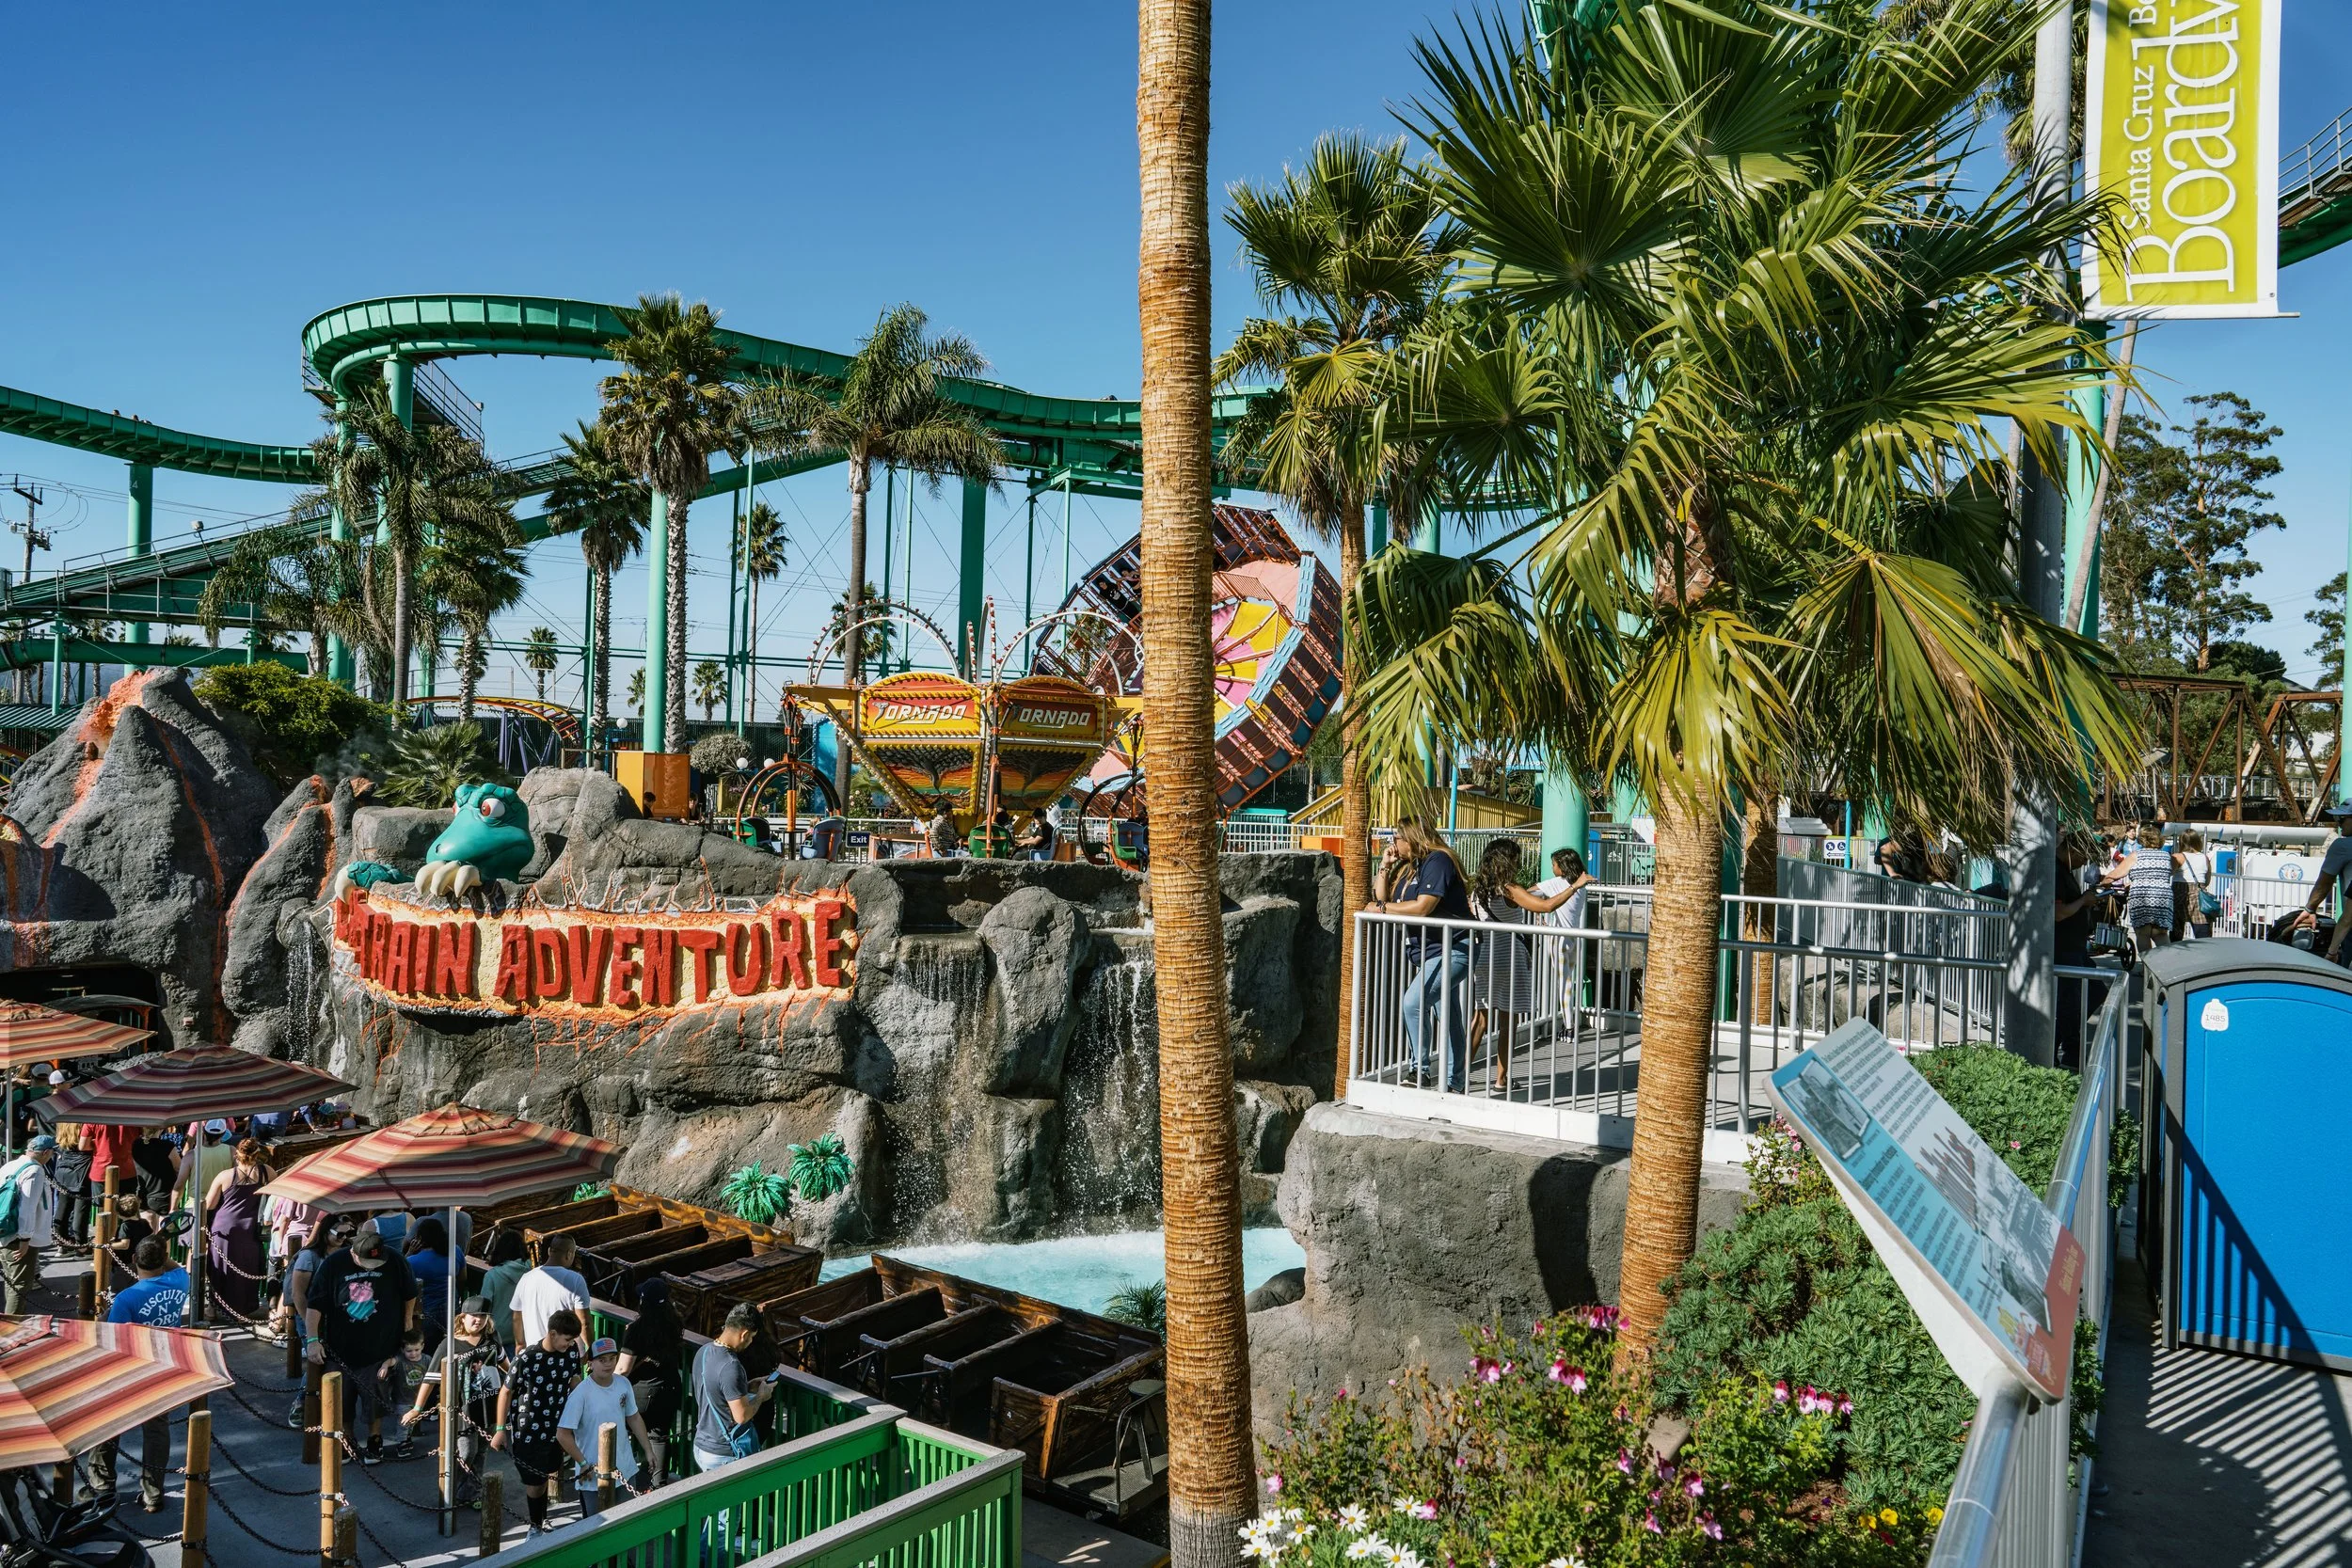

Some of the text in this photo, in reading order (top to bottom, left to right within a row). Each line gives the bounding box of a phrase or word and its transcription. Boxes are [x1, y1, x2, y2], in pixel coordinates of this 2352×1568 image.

[2123, 65, 2154, 142] Cruz
[2121, 147, 2153, 229] Santa
[871, 702, 968, 726] TORNADO
[850, 835, 867, 844] Exit
[491, 900, 847, 1006] ADVENTURE
[2205, 1014, 2226, 1023] 1485
[138, 1290, 186, 1317] BISCUITS
[158, 1301, 171, 1316] N'
[457, 1350, 475, 1362] ENNY
